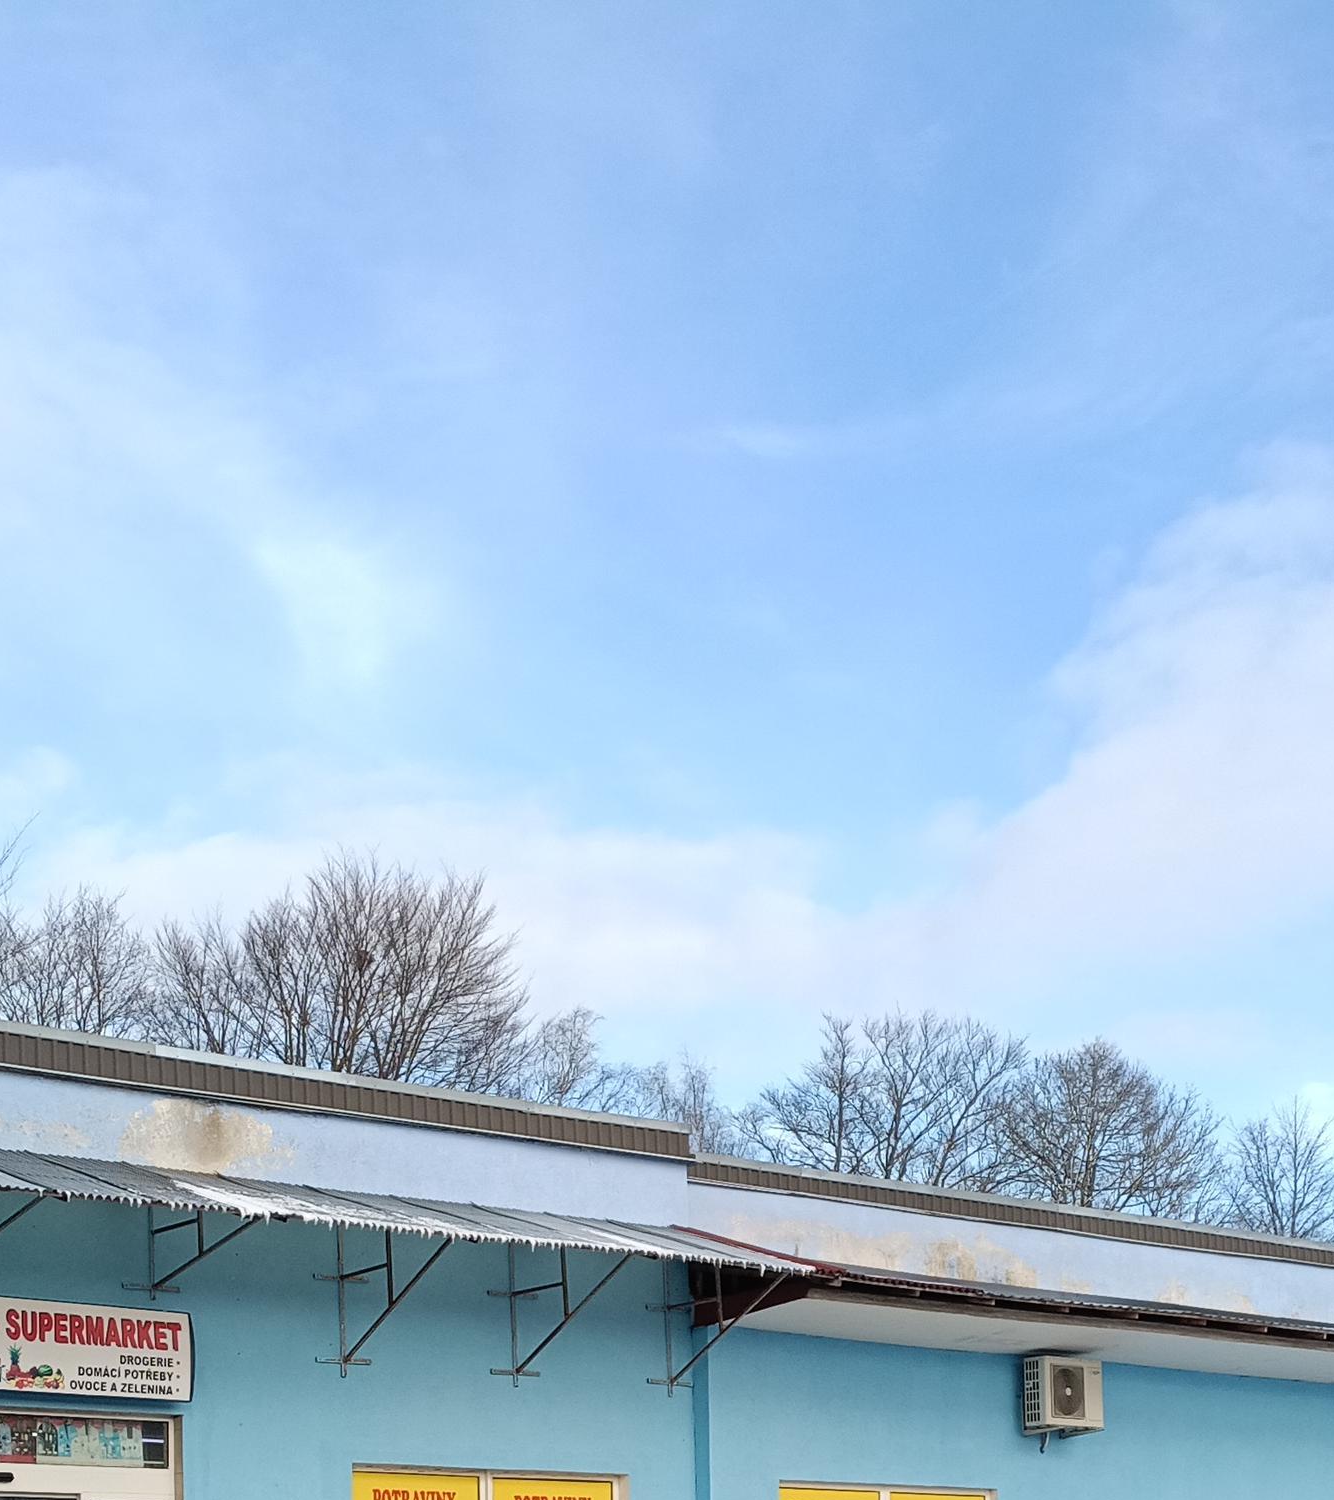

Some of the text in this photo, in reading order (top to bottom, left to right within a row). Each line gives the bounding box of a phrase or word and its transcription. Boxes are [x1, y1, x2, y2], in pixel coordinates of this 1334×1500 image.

[5, 1308, 182, 1352] SUPERMARKET
[119, 1354, 174, 1368] DROGERIE
[77, 1364, 174, 1382] DOMÁCÍ POTŘEBY
[69, 1380, 173, 1396] OVOCE A ZELENINA
